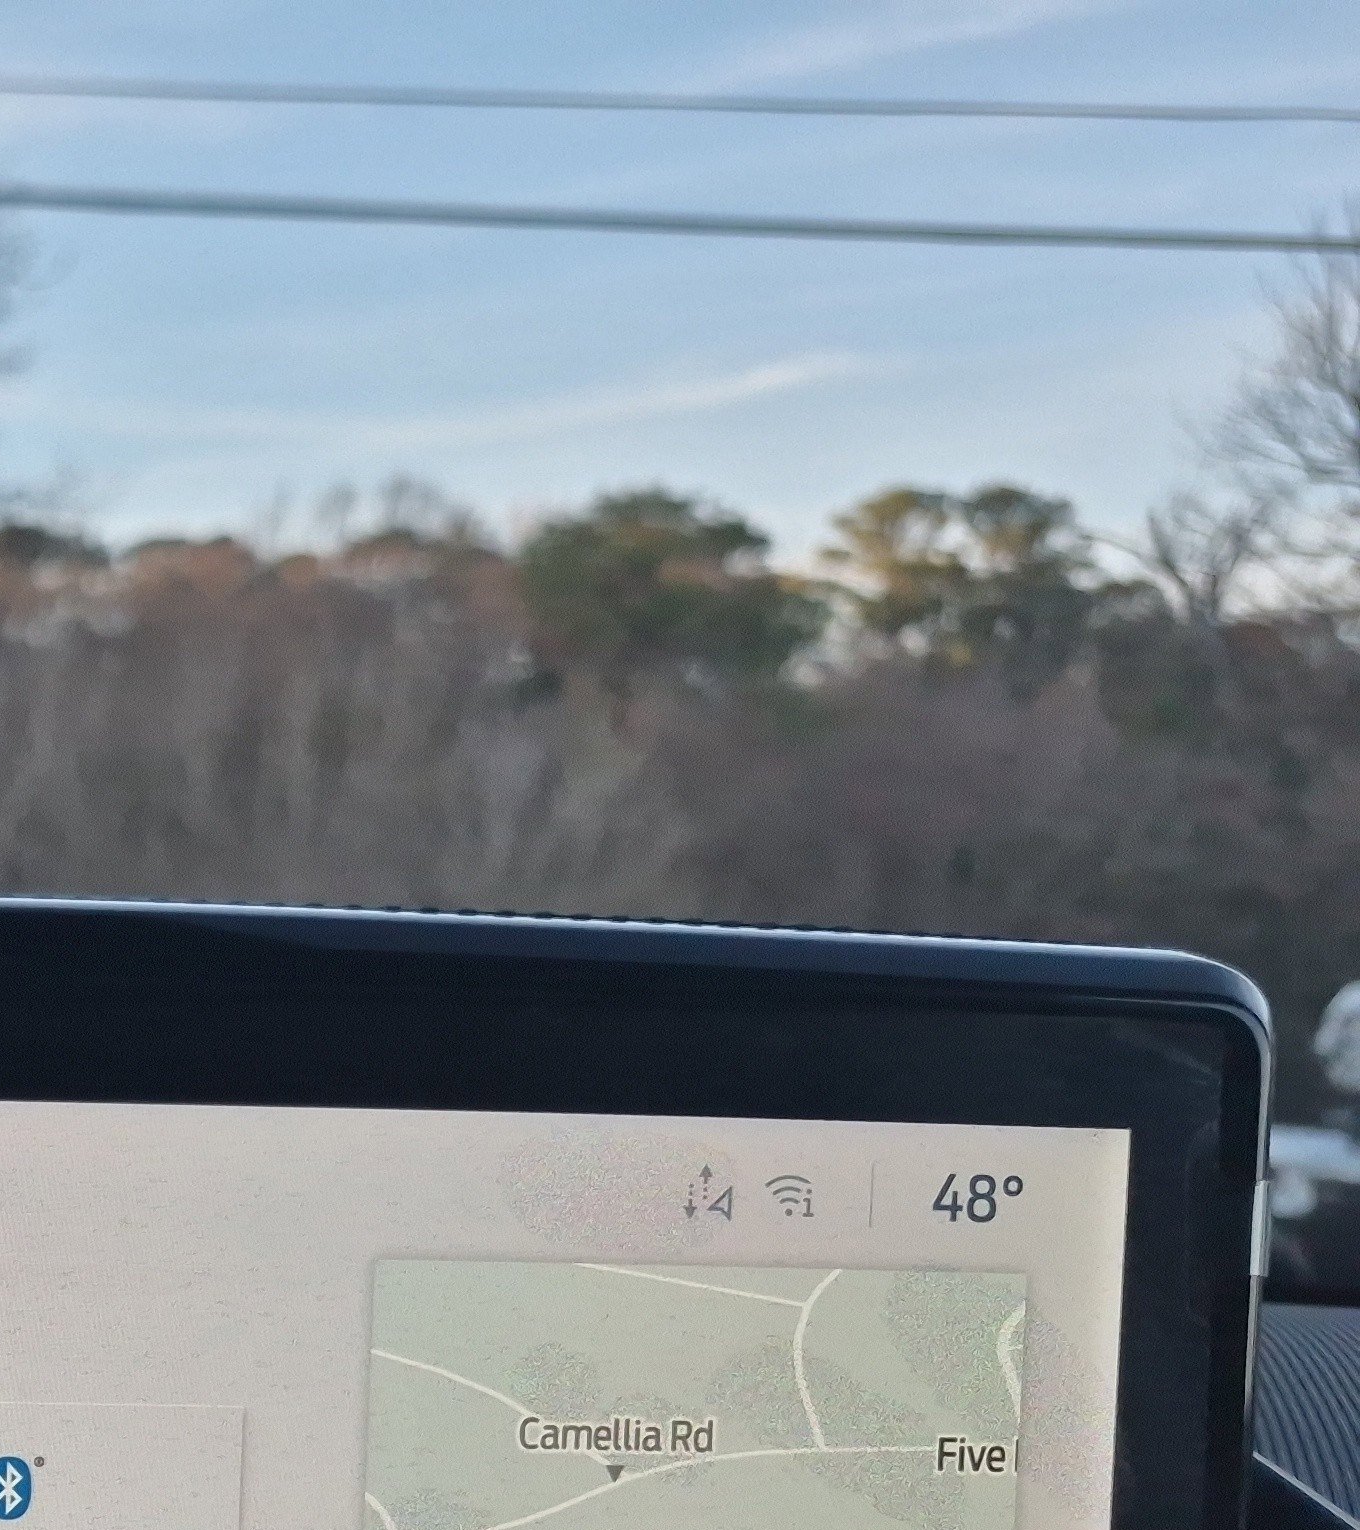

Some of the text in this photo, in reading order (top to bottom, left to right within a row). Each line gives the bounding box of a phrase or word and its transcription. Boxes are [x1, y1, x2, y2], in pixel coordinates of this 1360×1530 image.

[932, 1173, 1024, 1223] 48°
[519, 1416, 714, 1454] Camellia Rd
[936, 1436, 1007, 1473] Five
